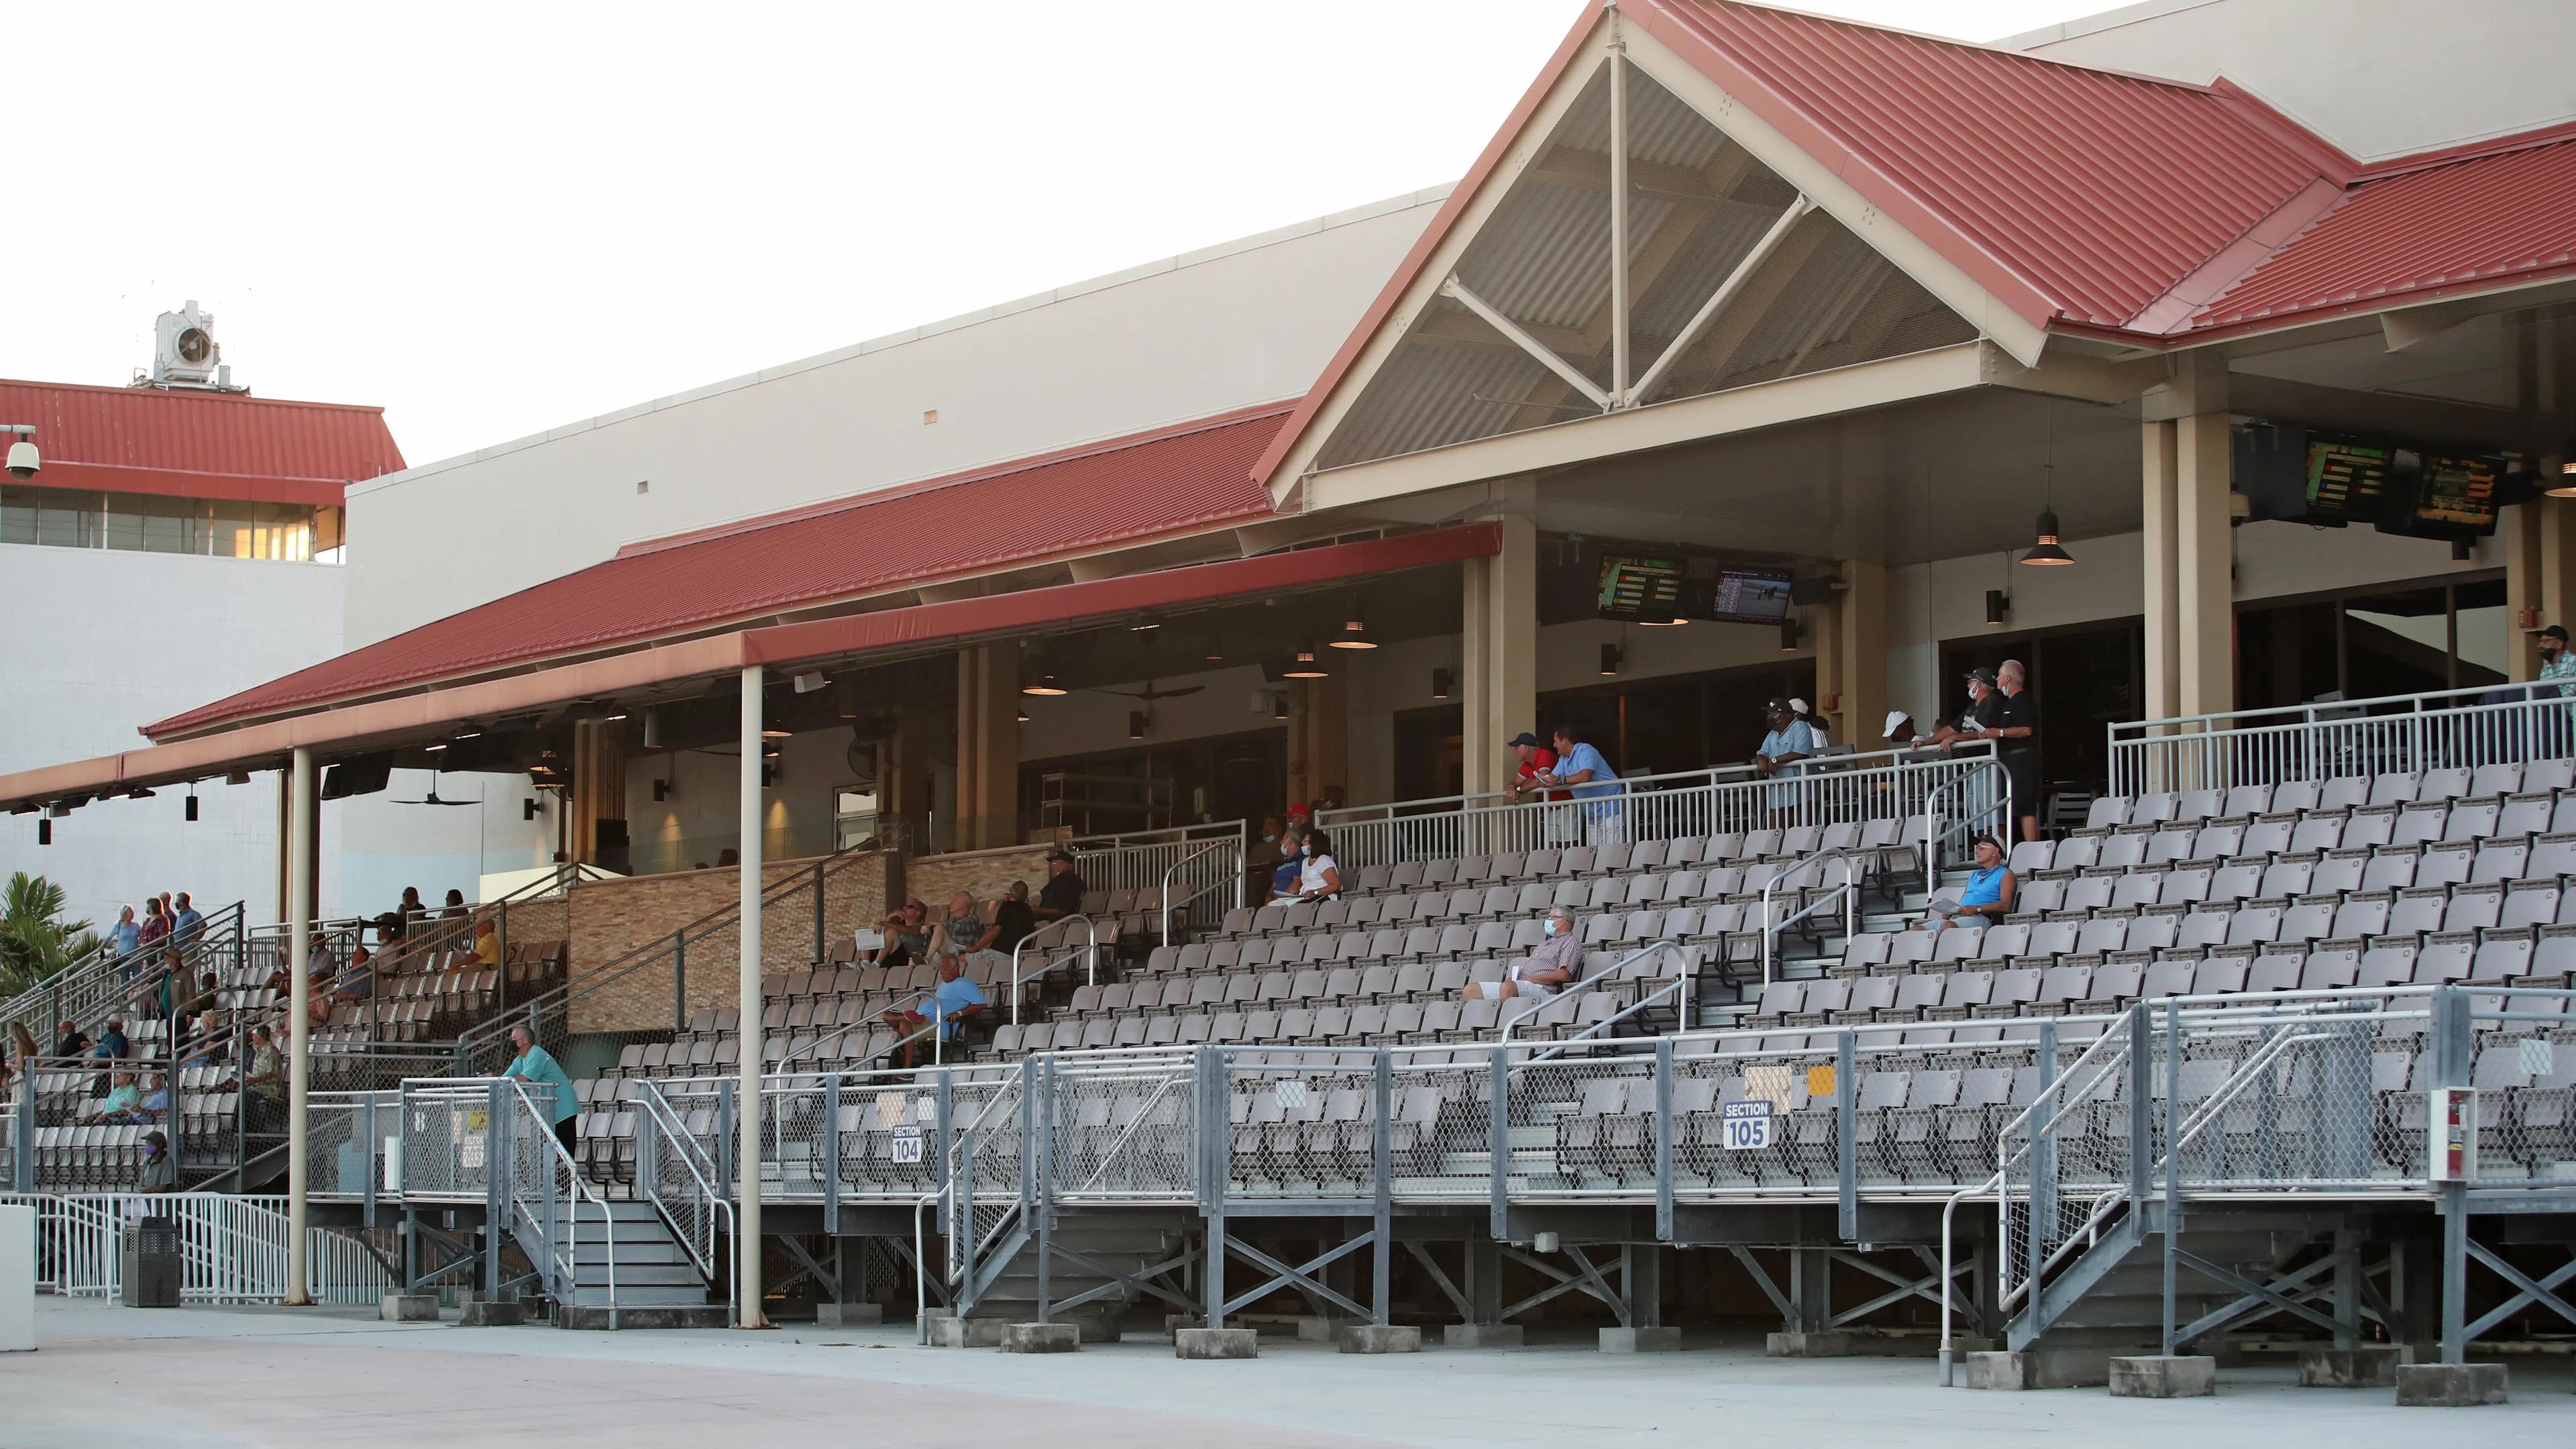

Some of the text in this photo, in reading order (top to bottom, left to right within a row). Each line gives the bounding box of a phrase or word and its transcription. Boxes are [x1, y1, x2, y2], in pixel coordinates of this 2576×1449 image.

[1726, 1103, 1768, 1116] SECTION
[894, 1126, 920, 1136] SECTION
[1730, 1121, 1764, 1146] 105
[896, 1140, 918, 1161] 104
